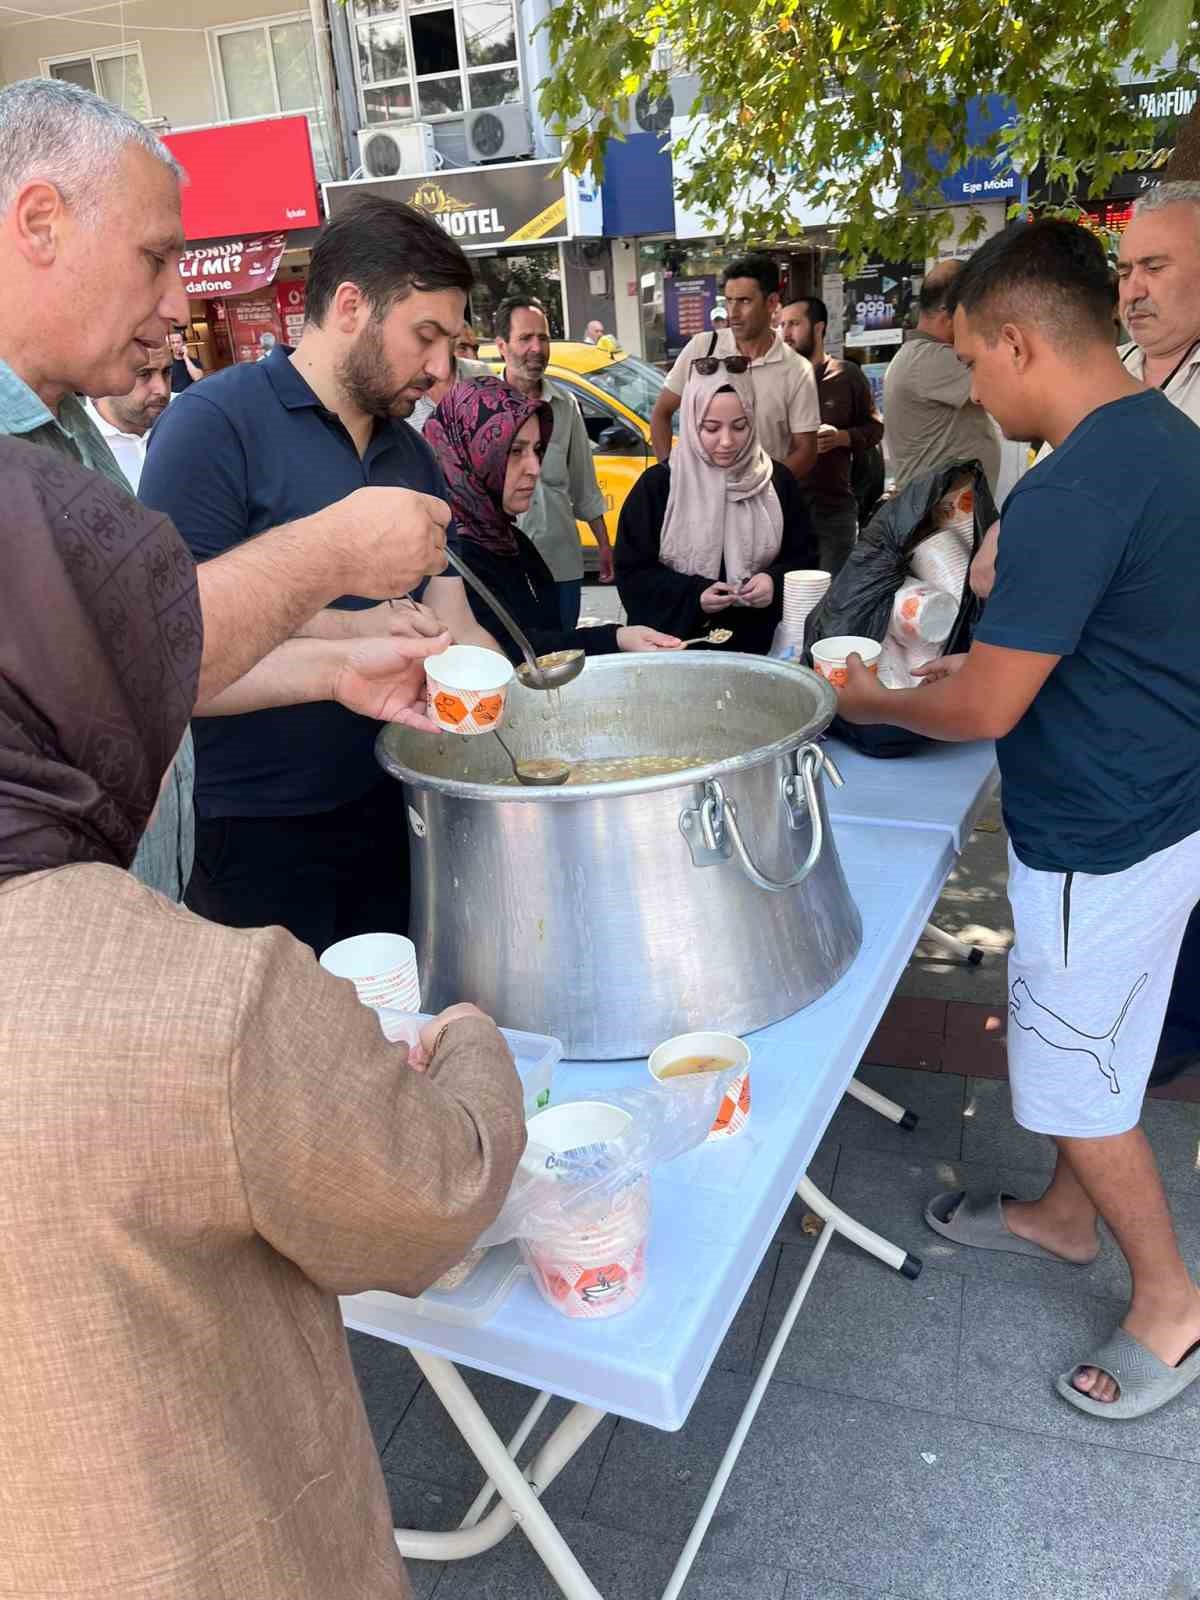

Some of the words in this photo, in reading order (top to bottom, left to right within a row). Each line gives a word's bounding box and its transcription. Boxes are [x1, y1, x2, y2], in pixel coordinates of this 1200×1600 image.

[962, 182, 982, 193] Ege
[983, 178, 1014, 190] Mobil
[179, 242, 244, 261] FONUN
[185, 280, 232, 293] dafone
